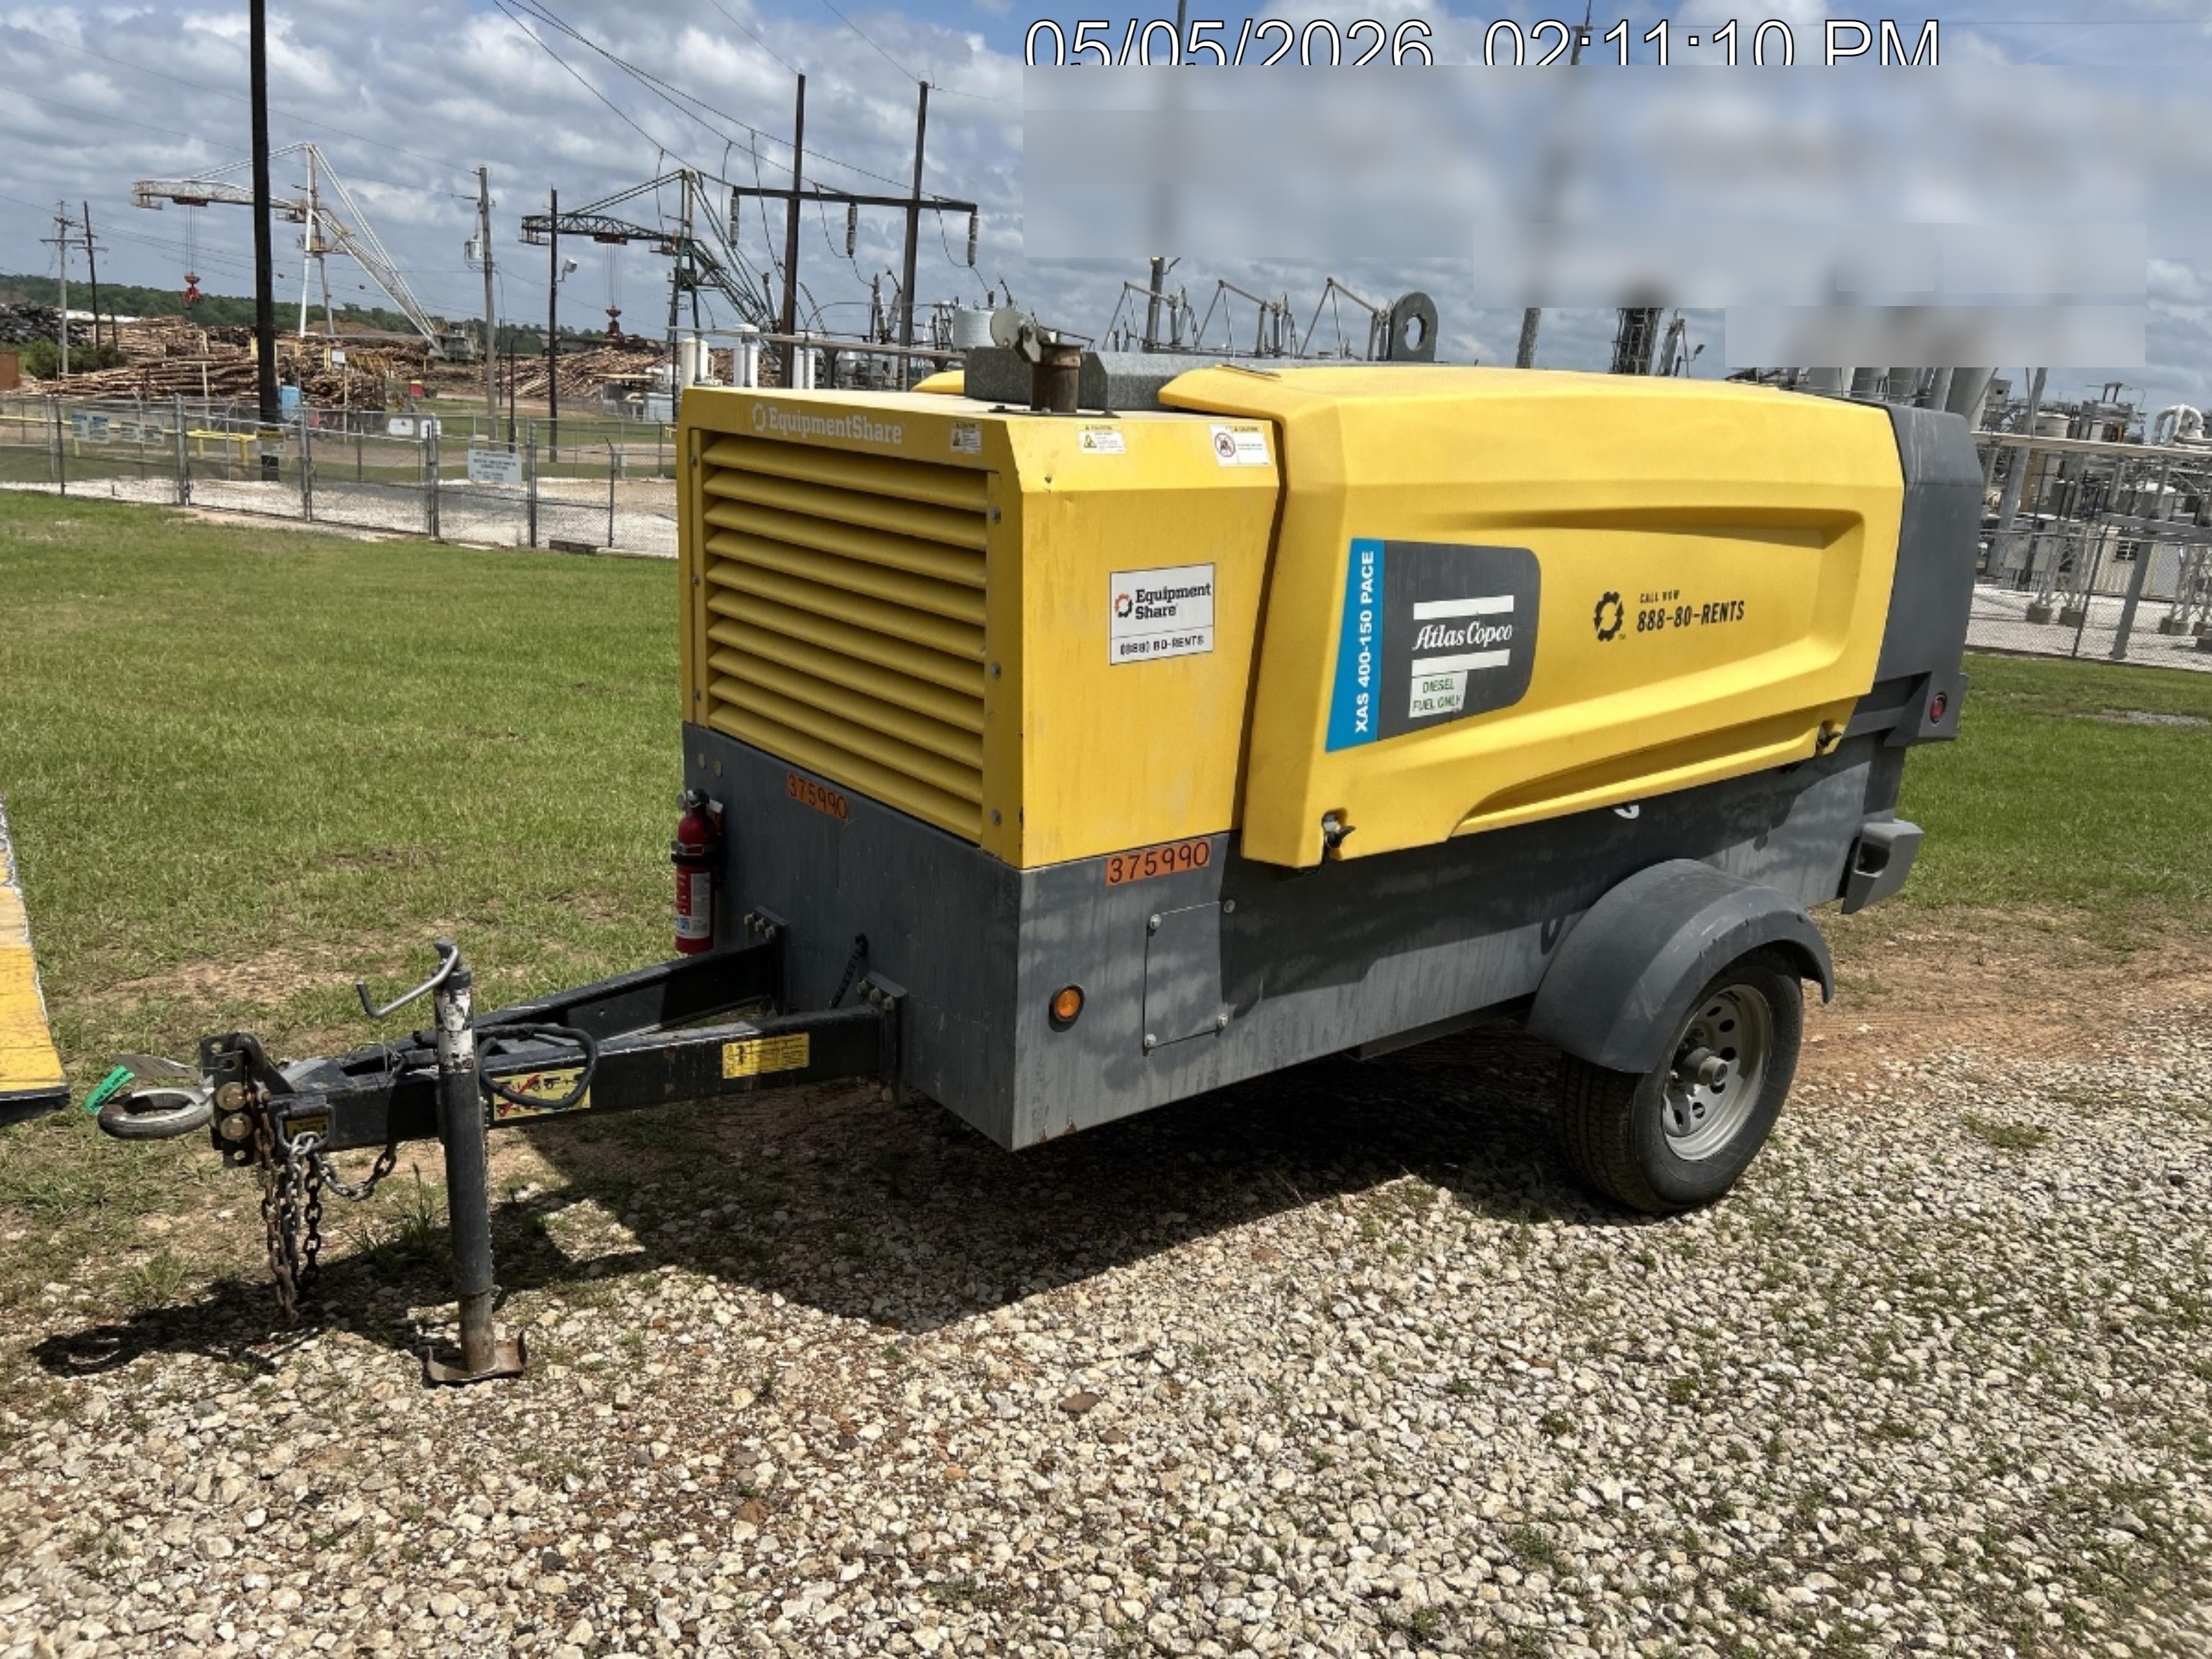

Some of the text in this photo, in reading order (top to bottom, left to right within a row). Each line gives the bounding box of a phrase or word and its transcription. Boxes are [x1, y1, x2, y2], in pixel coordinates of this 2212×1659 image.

[767, 406, 903, 444] EquipmentShare
[1135, 581, 1212, 605] Equipment
[1640, 592, 1659, 603] CALL
[1135, 606, 1177, 621] Share
[1637, 600, 1745, 633] 888-80-RENTS
[1354, 551, 1374, 733] XAS 400-150 PACE
[1411, 621, 1513, 651] Atlas Copco
[1422, 678, 1454, 693] DIESEL
[1412, 698, 1435, 712] FUEL
[788, 772, 847, 820] 375990
[1109, 841, 1210, 884] 375990
